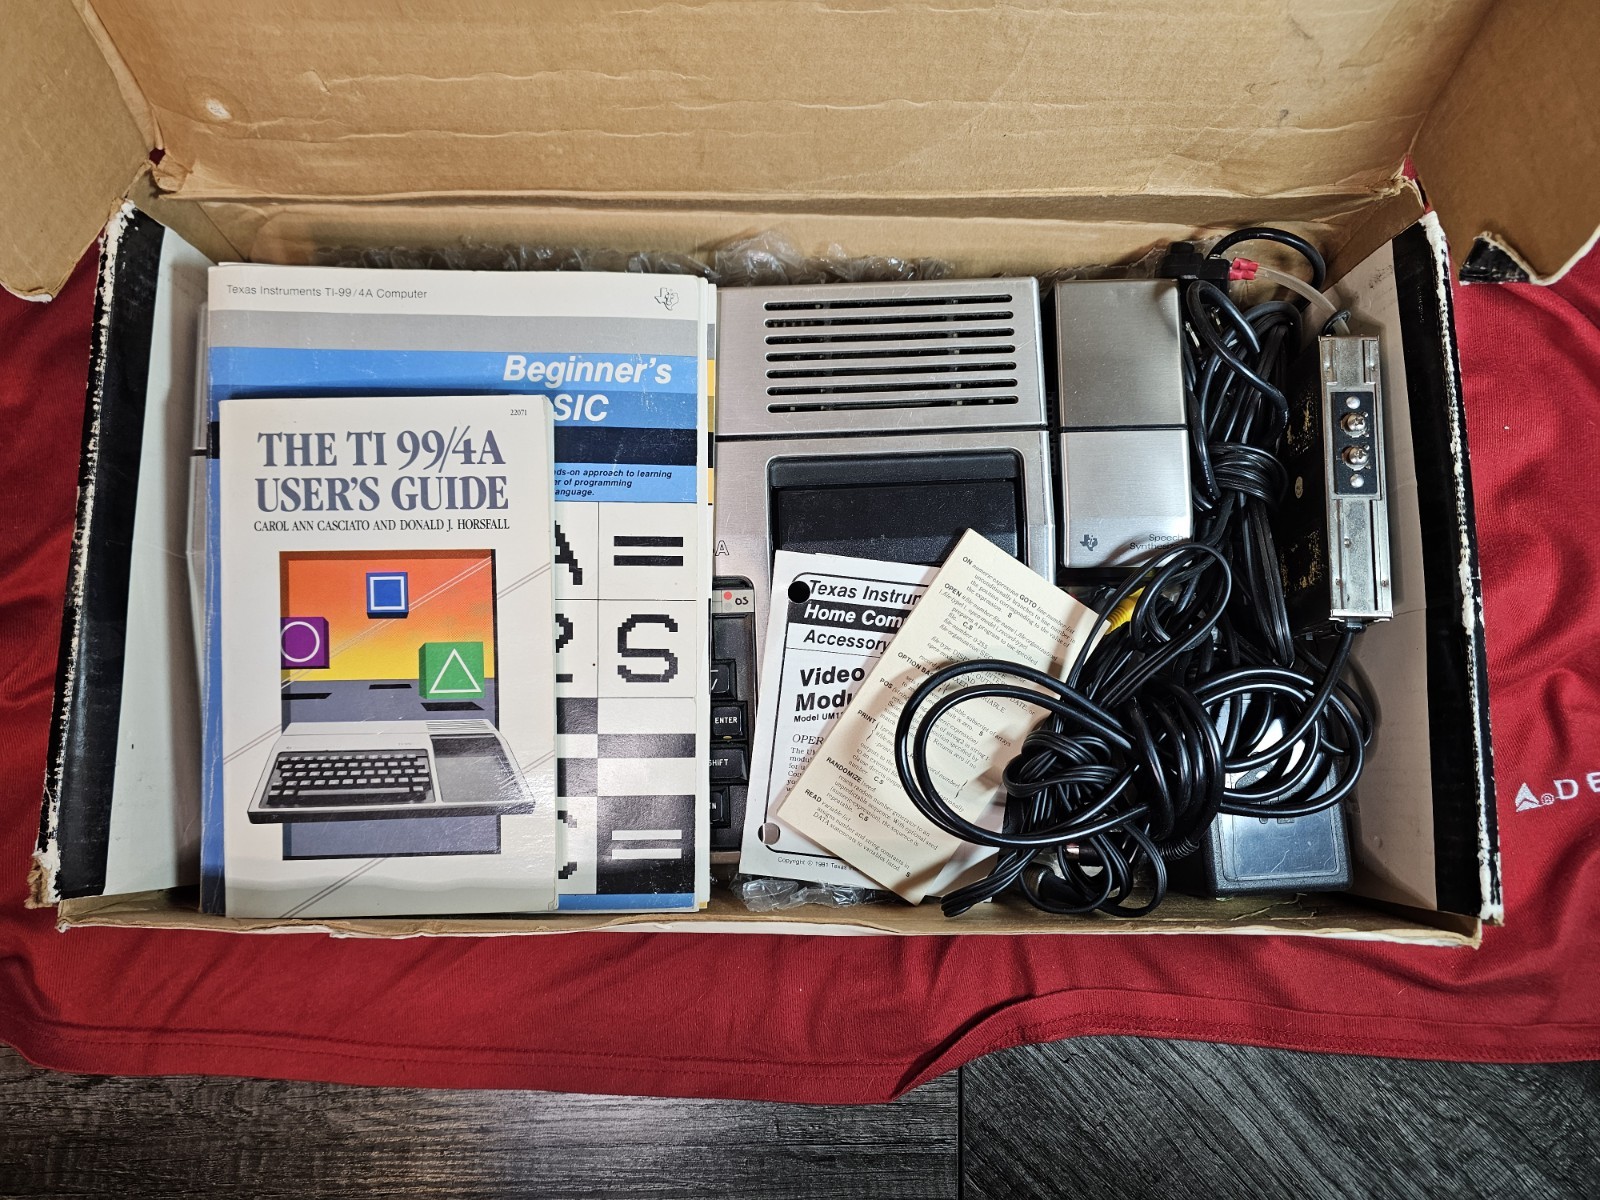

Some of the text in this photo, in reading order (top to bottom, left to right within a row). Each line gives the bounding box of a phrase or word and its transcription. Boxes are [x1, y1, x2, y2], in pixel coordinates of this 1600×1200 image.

[226, 285, 257, 295] Texas
[260, 286, 321, 296] Instruments
[376, 288, 427, 299] Computer
[503, 354, 672, 389] Beginner's
[258, 425, 506, 473] THE TI 99/4A
[574, 480, 632, 488] programming
[583, 470, 623, 478] approach
[637, 470, 672, 479] learning
[255, 475, 508, 513] USER'S GUIDE
[254, 518, 510, 532] CAROL ANN CASCIATO AND DONALD J. HORSFALL
[808, 580, 858, 599] Texas
[943, 582, 962, 597] OPEN
[961, 555, 972, 565] ON
[1018, 593, 1037, 609] GOTO
[804, 603, 908, 629] Home Com
[973, 573, 1012, 601] unconditionally
[1011, 598, 1035, 616] branches
[1049, 624, 1070, 640] number
[978, 585, 1000, 602] position
[997, 598, 1034, 625] corresponding
[1048, 631, 1063, 643] value
[950, 606, 974, 624] prepares
[1014, 647, 1038, 666] specified
[896, 651, 921, 670] OPTION
[800, 666, 865, 687] Video
[878, 677, 893, 689] POS
[714, 716, 738, 724] ENTER
[794, 714, 819, 722] Model
[856, 709, 876, 724] PRINT
[965, 713, 990, 733] subscript
[993, 733, 1012, 748] arrays
[932, 737, 954, 754] Returns
[953, 751, 965, 762] zero
[949, 740, 972, 758] specified
[825, 756, 863, 783] RANDOMIZE
[851, 754, 869, 767] clause
[868, 756, 891, 773] external
[803, 788, 822, 803] READ
[833, 779, 868, 805] unpredictable
[891, 817, 906, 829] With
[904, 825, 926, 843] optional
[925, 839, 939, 851] seed
[852, 784, 873, 800] random
[872, 796, 893, 813] number
[891, 809, 917, 829] generator
[812, 811, 830, 825] DATA
[829, 822, 857, 843] statements
[862, 843, 887, 862] variables
[815, 806, 835, 822] assigns
[835, 817, 855, 833] number
[854, 830, 866, 840] and
[864, 837, 880, 850] string
[889, 826, 914, 845] sequence
[777, 856, 805, 867] Copyright
